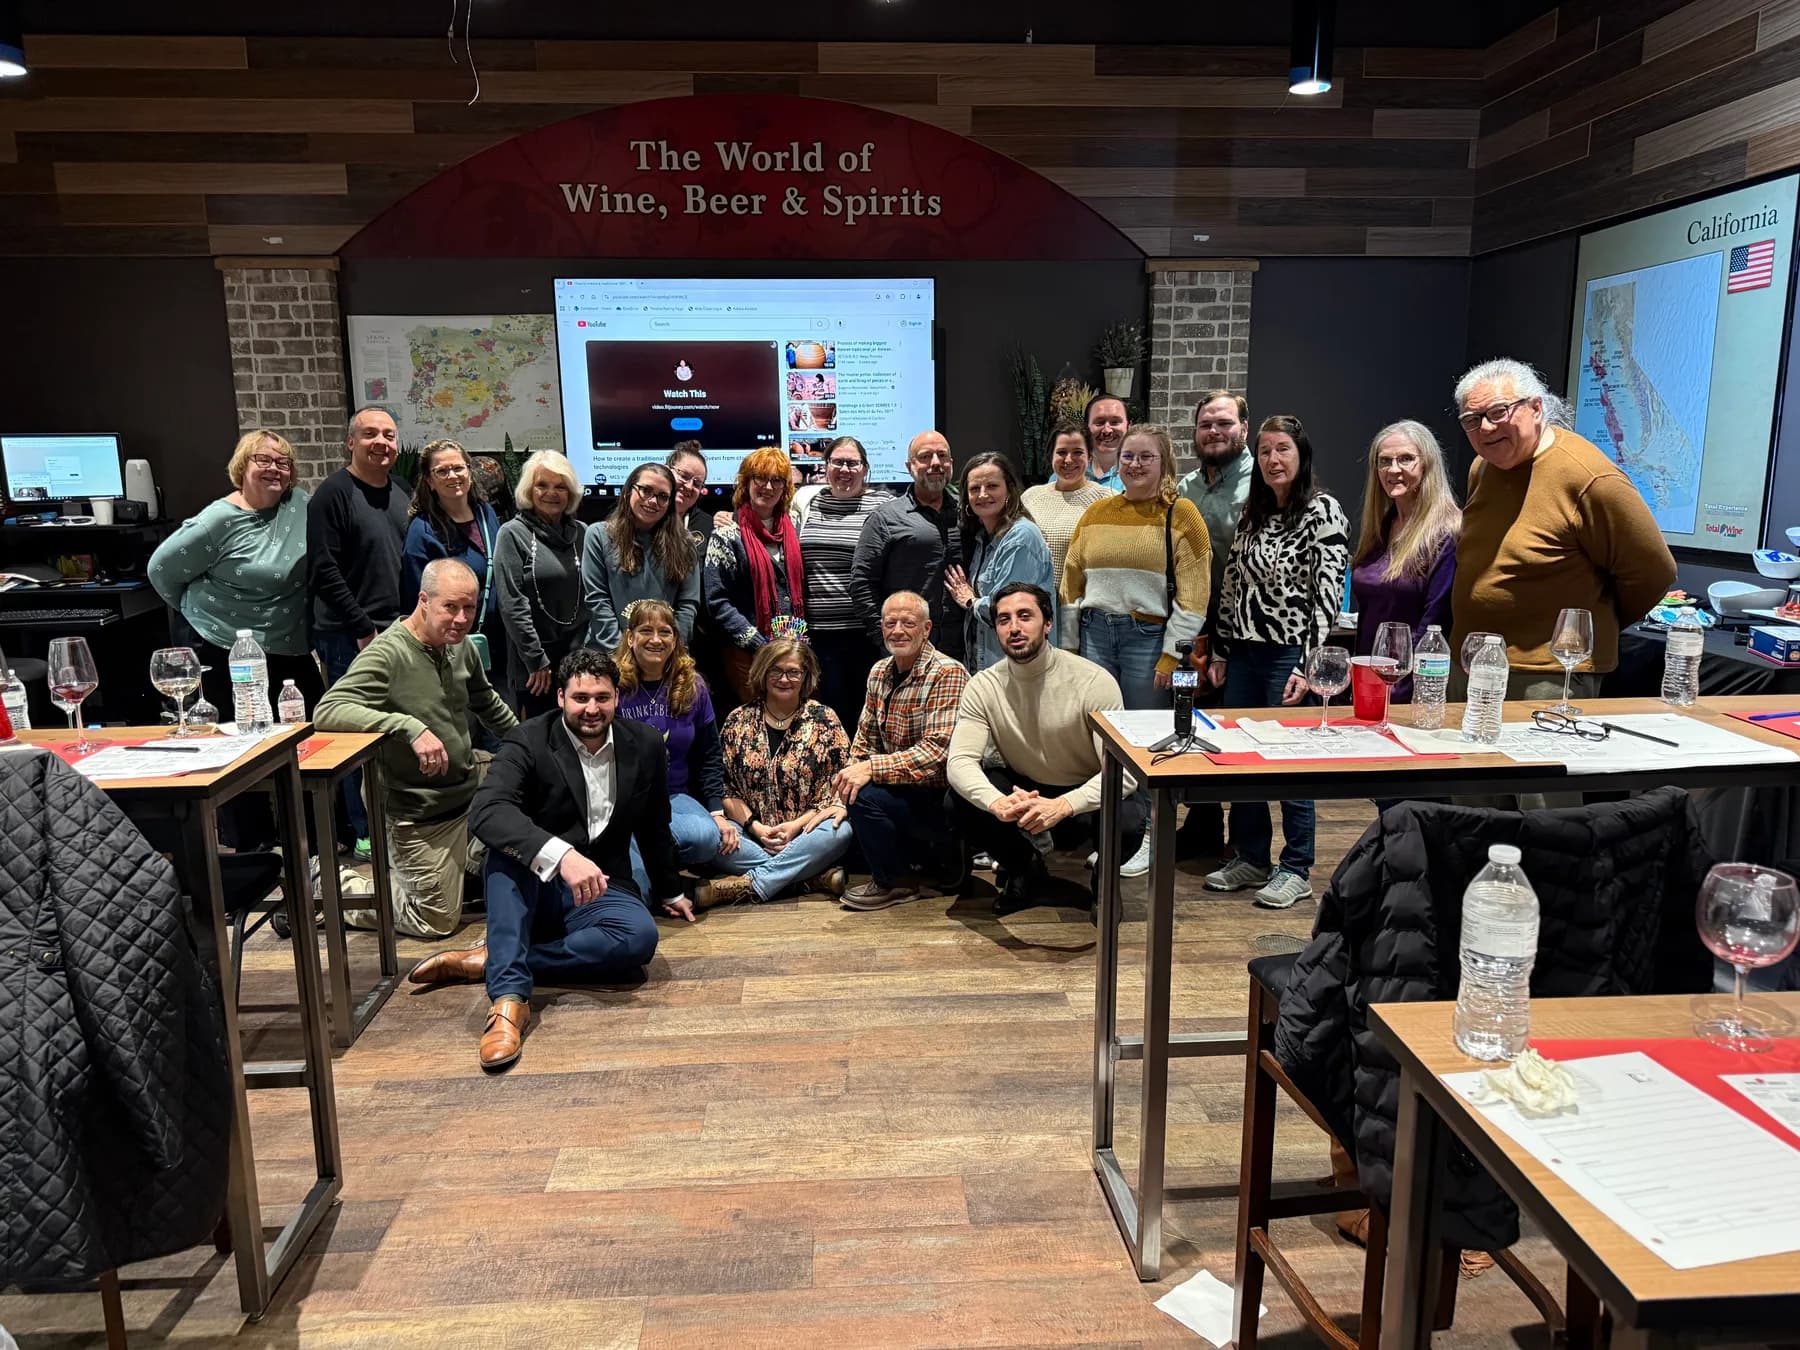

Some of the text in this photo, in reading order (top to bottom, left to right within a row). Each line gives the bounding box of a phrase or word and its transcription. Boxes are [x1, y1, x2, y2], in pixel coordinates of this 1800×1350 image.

[630, 140, 875, 173] The World of
[559, 183, 942, 225] Wine, Beer & Spirits
[1687, 204, 1780, 245] California
[663, 388, 707, 398] Watch This
[1705, 523, 1744, 535] Total Wine
[621, 703, 679, 720] DRINKERBE
